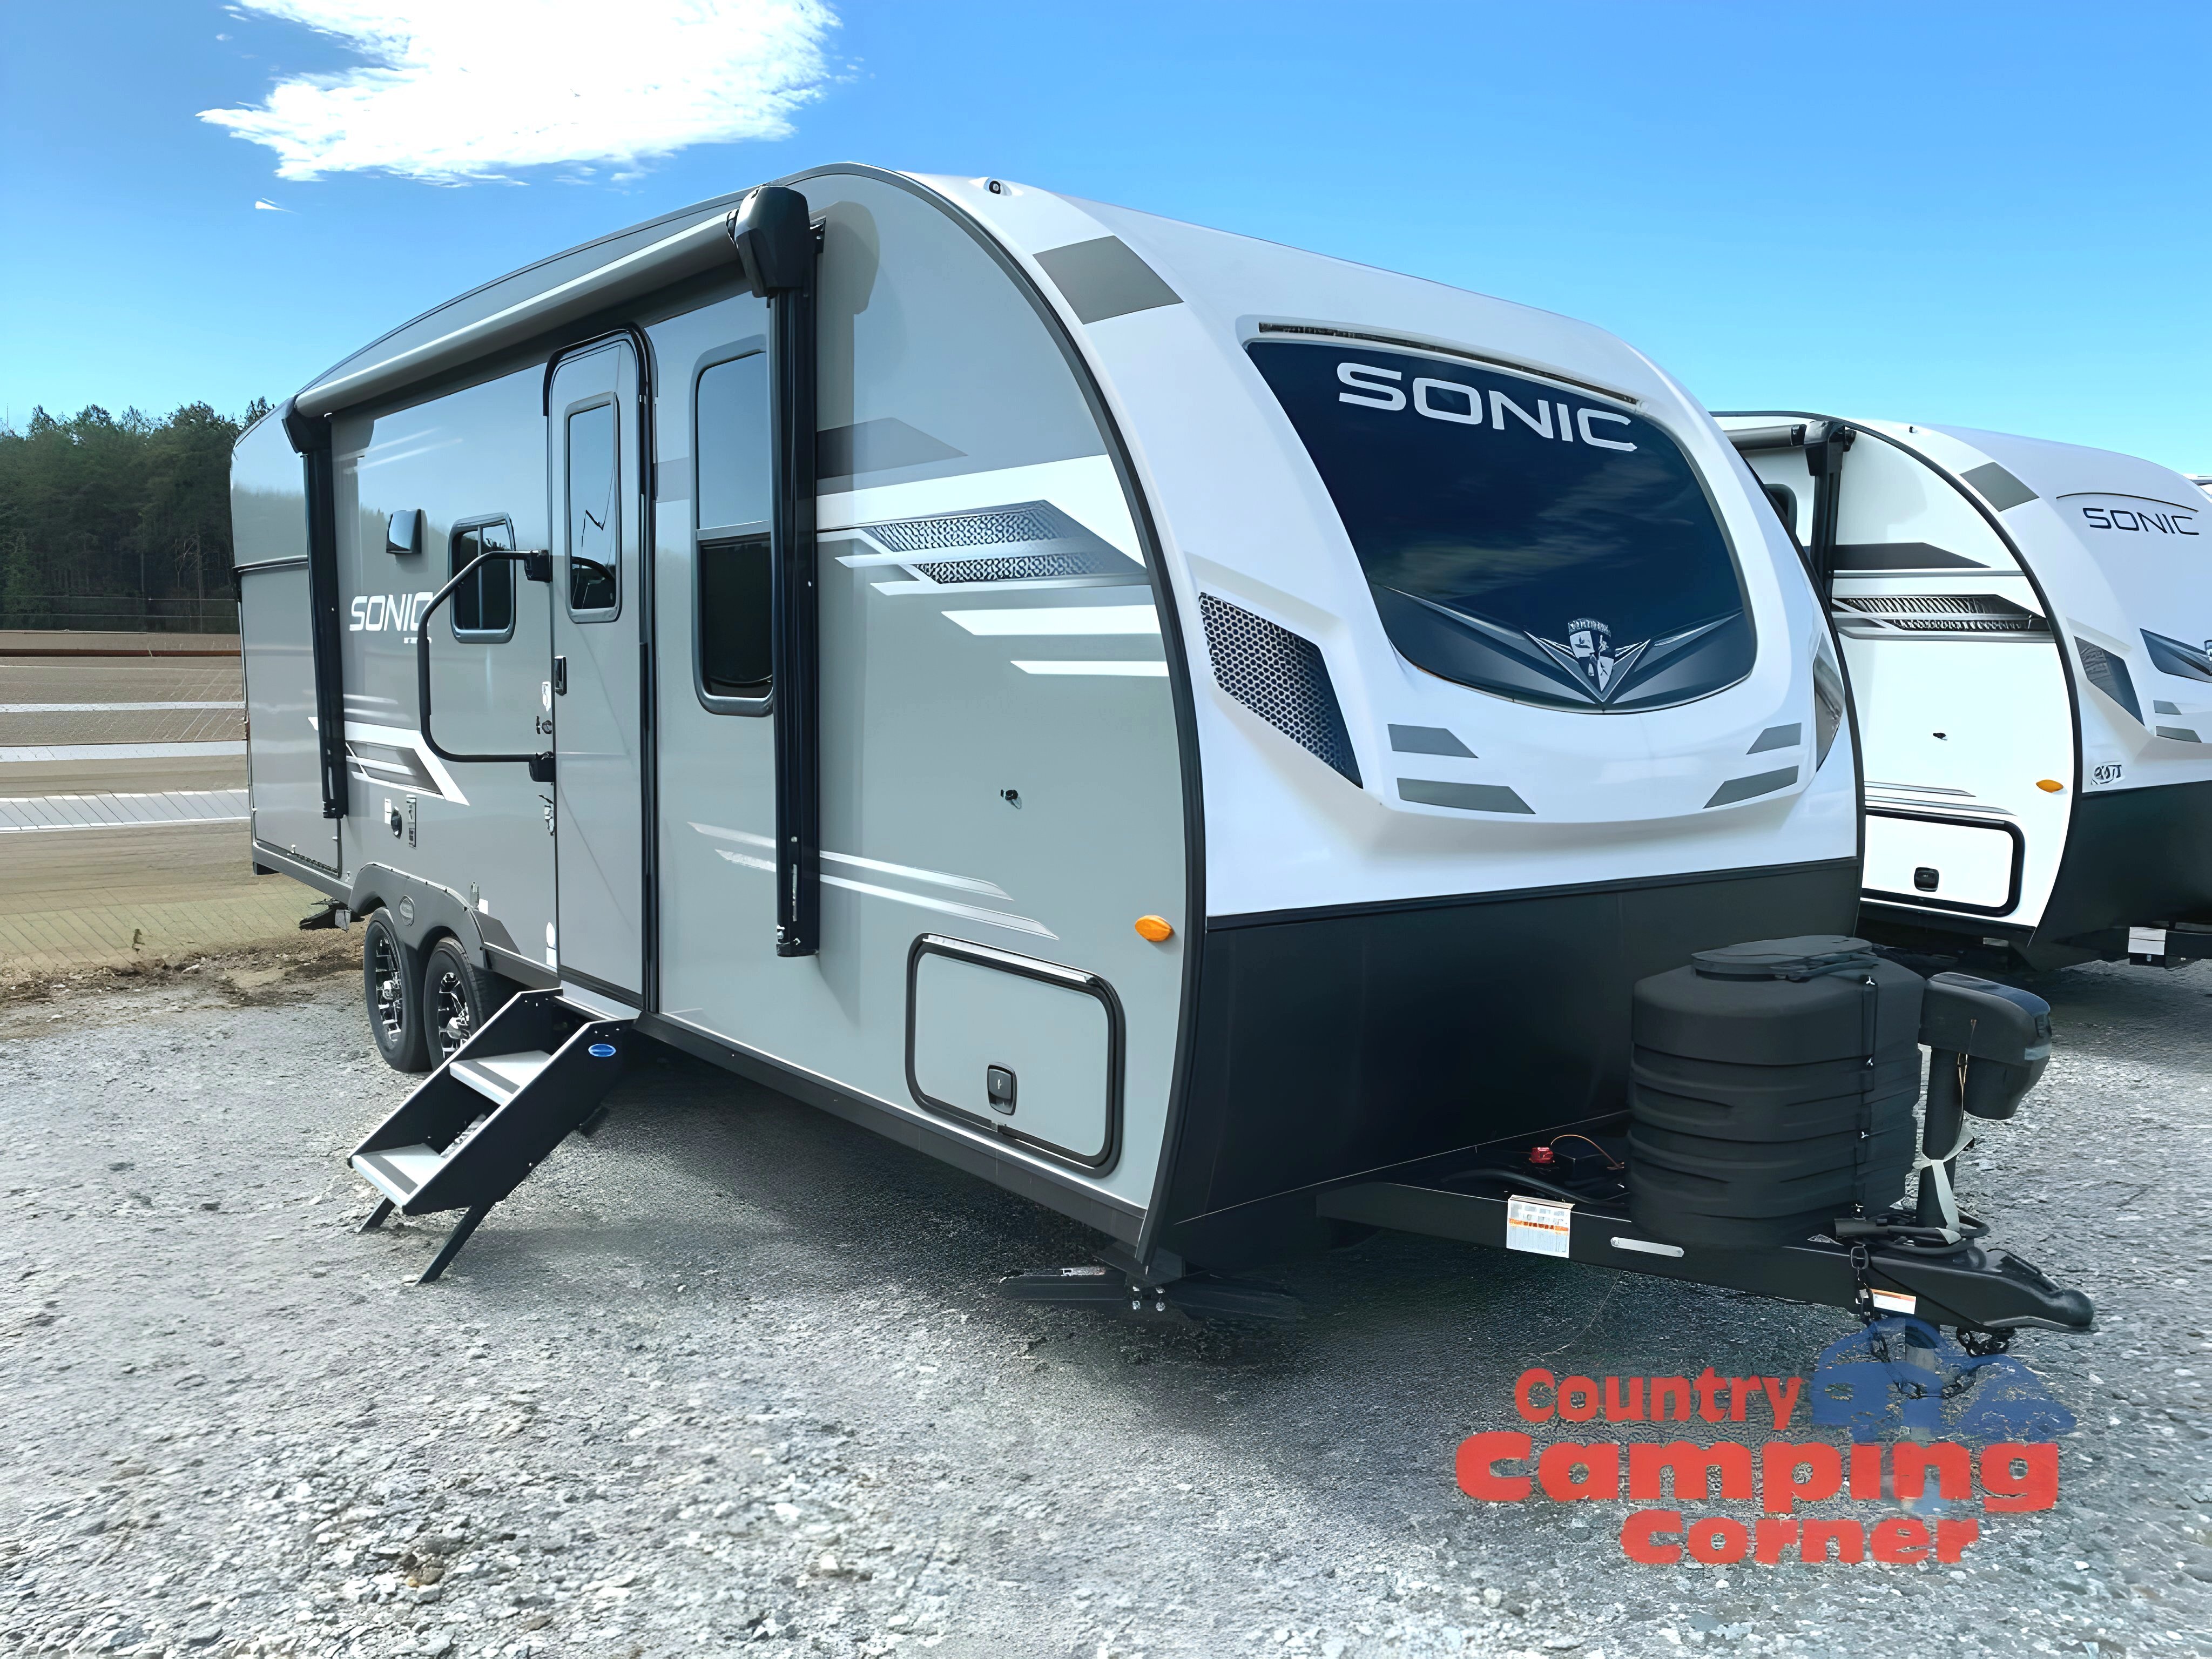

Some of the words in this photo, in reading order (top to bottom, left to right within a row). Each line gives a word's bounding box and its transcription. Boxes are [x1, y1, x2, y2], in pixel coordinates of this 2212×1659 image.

[1337, 362, 1637, 451] SONIC
[2082, 508, 2200, 536] SONIC
[349, 592, 434, 631] SONIC
